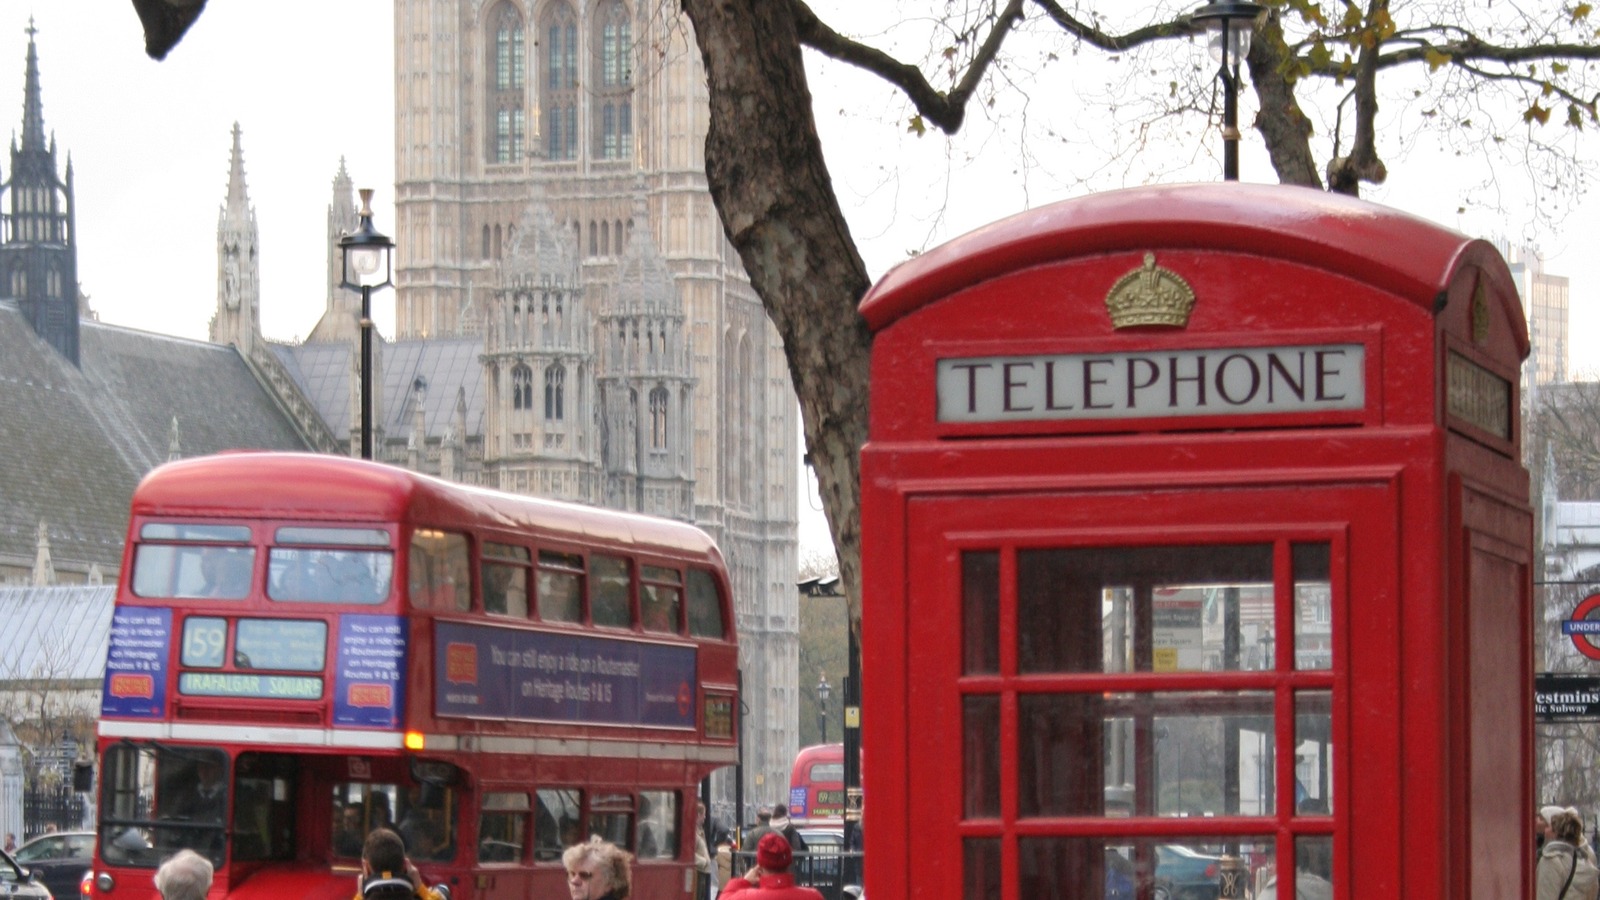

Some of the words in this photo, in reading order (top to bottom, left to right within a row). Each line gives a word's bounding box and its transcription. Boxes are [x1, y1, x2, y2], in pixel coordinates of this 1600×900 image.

[950, 350, 1347, 413] TELEPHONE
[114, 616, 129, 624] You
[130, 617, 145, 625] can
[146, 616, 162, 626] still
[351, 624, 368, 634] You
[369, 626, 384, 634] can
[385, 625, 401, 635] still
[114, 638, 165, 648] Routemaster
[184, 628, 225, 659] 159
[343, 637, 368, 647] enjoy
[376, 637, 392, 646] ride
[393, 638, 405, 646] on
[111, 651, 122, 659] on
[351, 647, 404, 658] Routemaster
[348, 660, 361, 668] on
[361, 659, 397, 670] Heritage
[343, 669, 373, 680] Routes
[186, 674, 261, 694] TRAFALGAR
[269, 676, 322, 697] SQUARE
[1535, 691, 1599, 704] estmins
[1550, 705, 1587, 715] Subway
